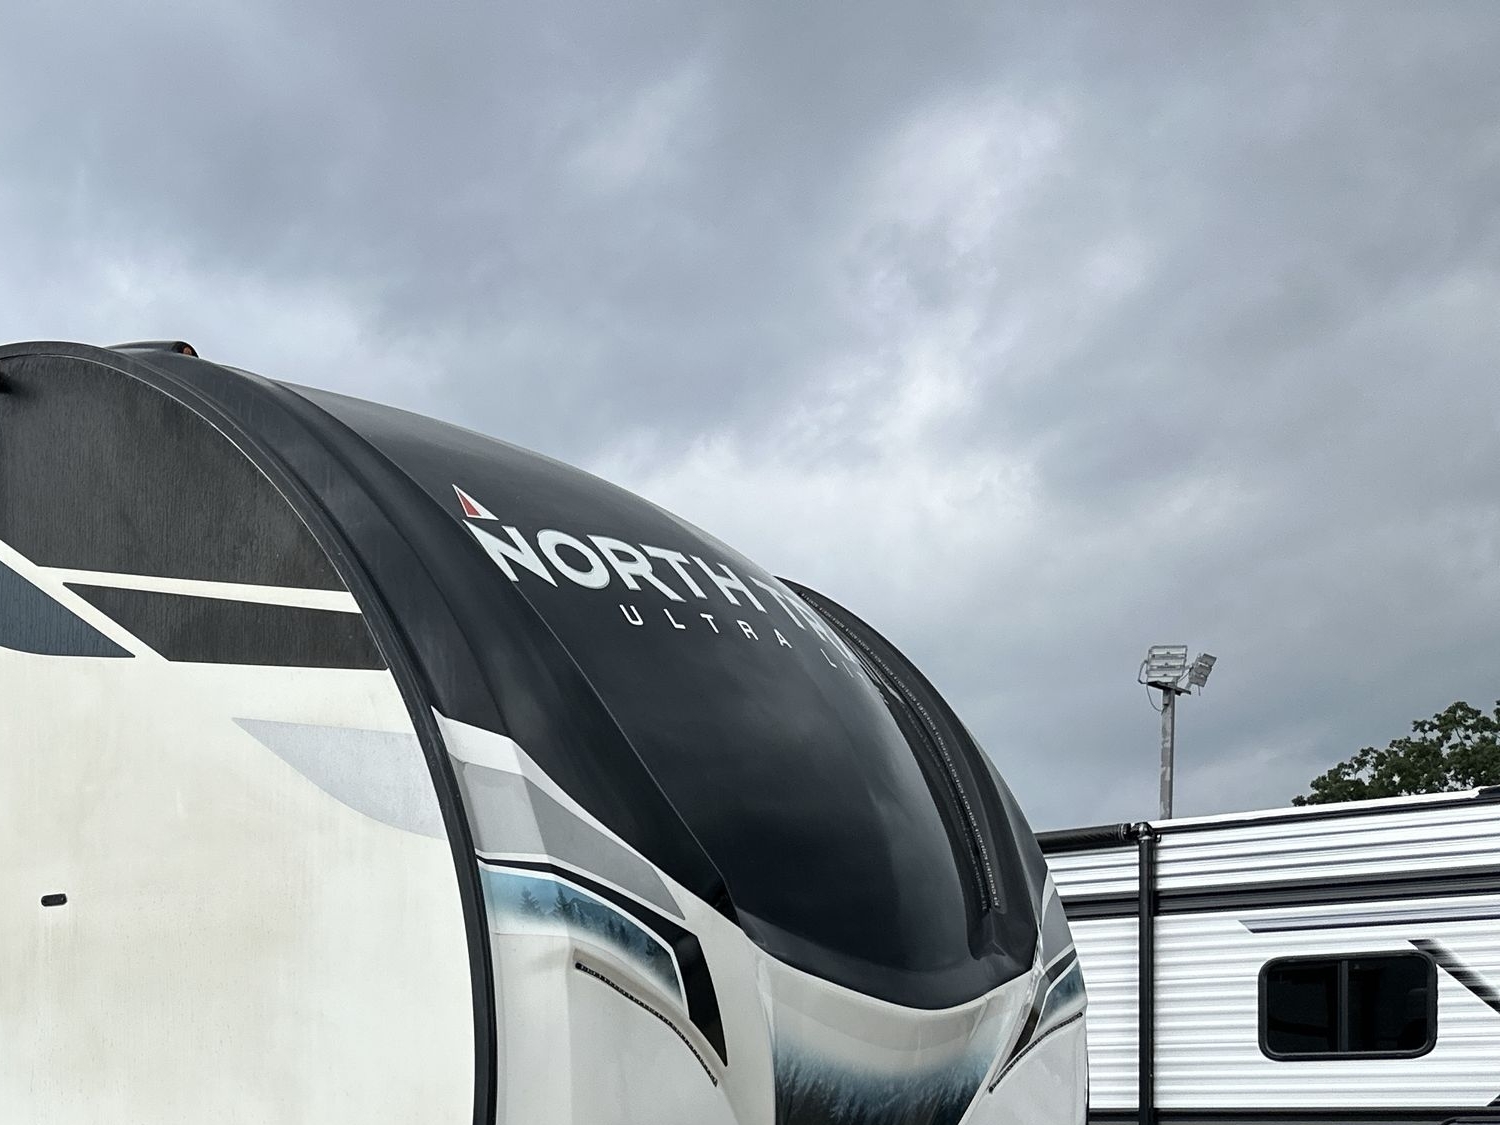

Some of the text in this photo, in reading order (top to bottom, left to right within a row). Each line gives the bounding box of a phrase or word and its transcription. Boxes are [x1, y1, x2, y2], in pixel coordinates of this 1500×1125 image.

[462, 519, 858, 664] NORTH TRA
[620, 605, 793, 648] ULTRA
